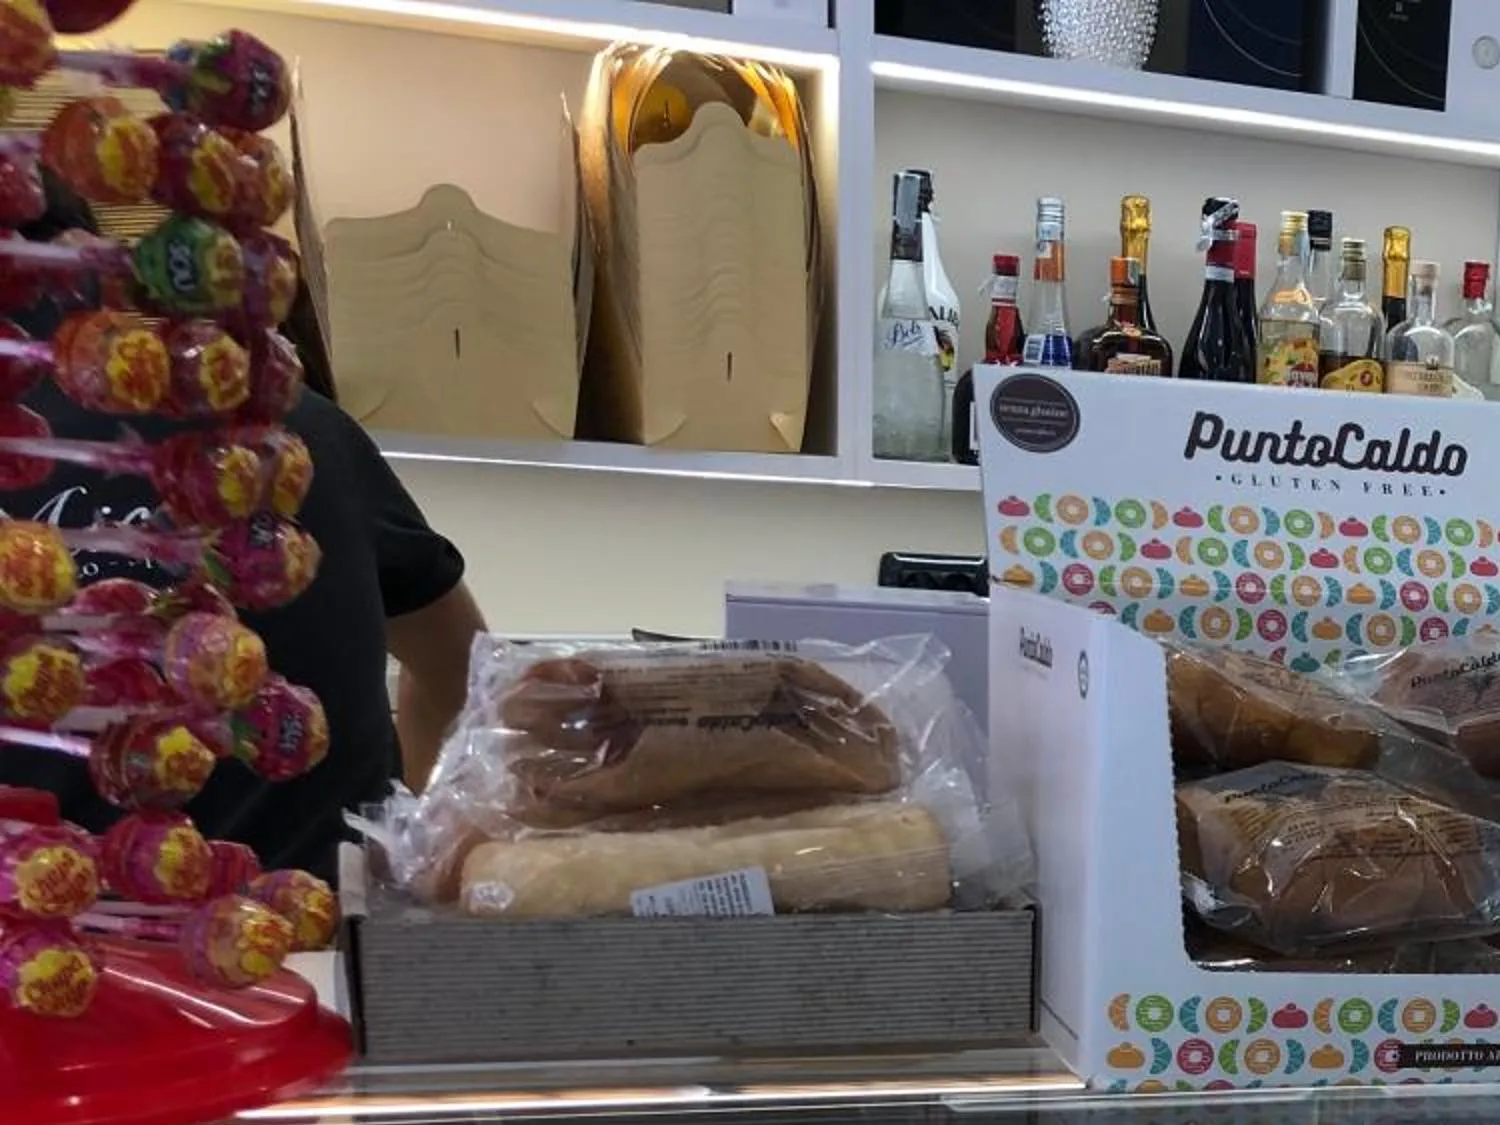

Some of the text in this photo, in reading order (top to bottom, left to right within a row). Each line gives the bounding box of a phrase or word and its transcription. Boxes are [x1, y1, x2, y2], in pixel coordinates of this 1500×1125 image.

[1184, 411, 1468, 477] PuntoCaldo
[1231, 473, 1433, 497] GLUTEN FREE
